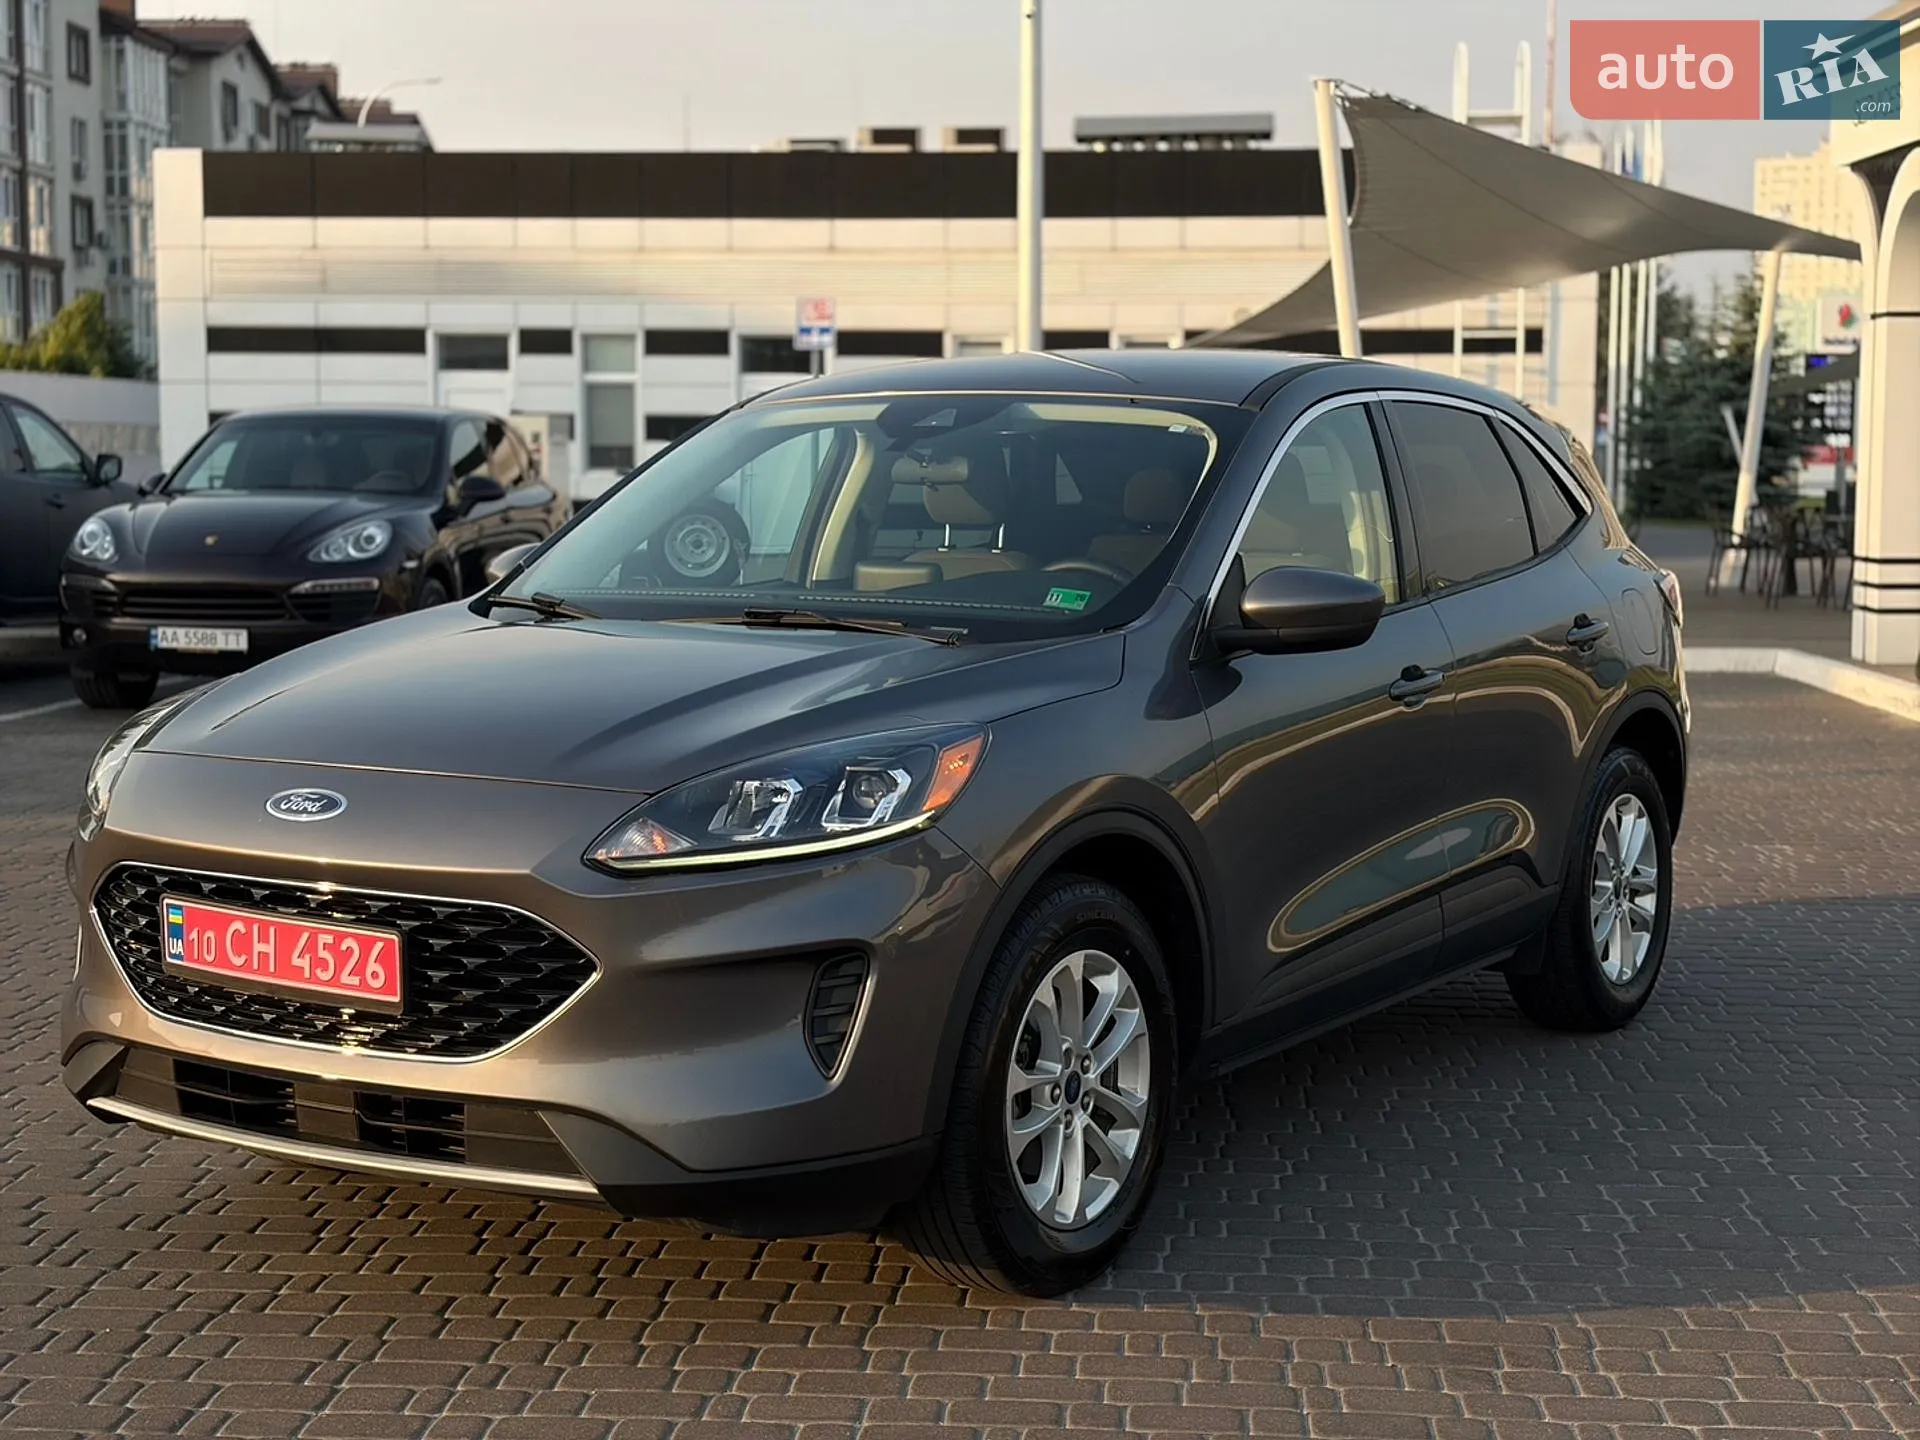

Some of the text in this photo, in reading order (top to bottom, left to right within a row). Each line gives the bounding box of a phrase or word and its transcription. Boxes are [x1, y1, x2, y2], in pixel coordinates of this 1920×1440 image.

[159, 629, 243, 647] AA 5588 TT
[280, 793, 329, 813] Ford
[168, 937, 185, 956] UA
[188, 919, 387, 990] 10 CH 4526
